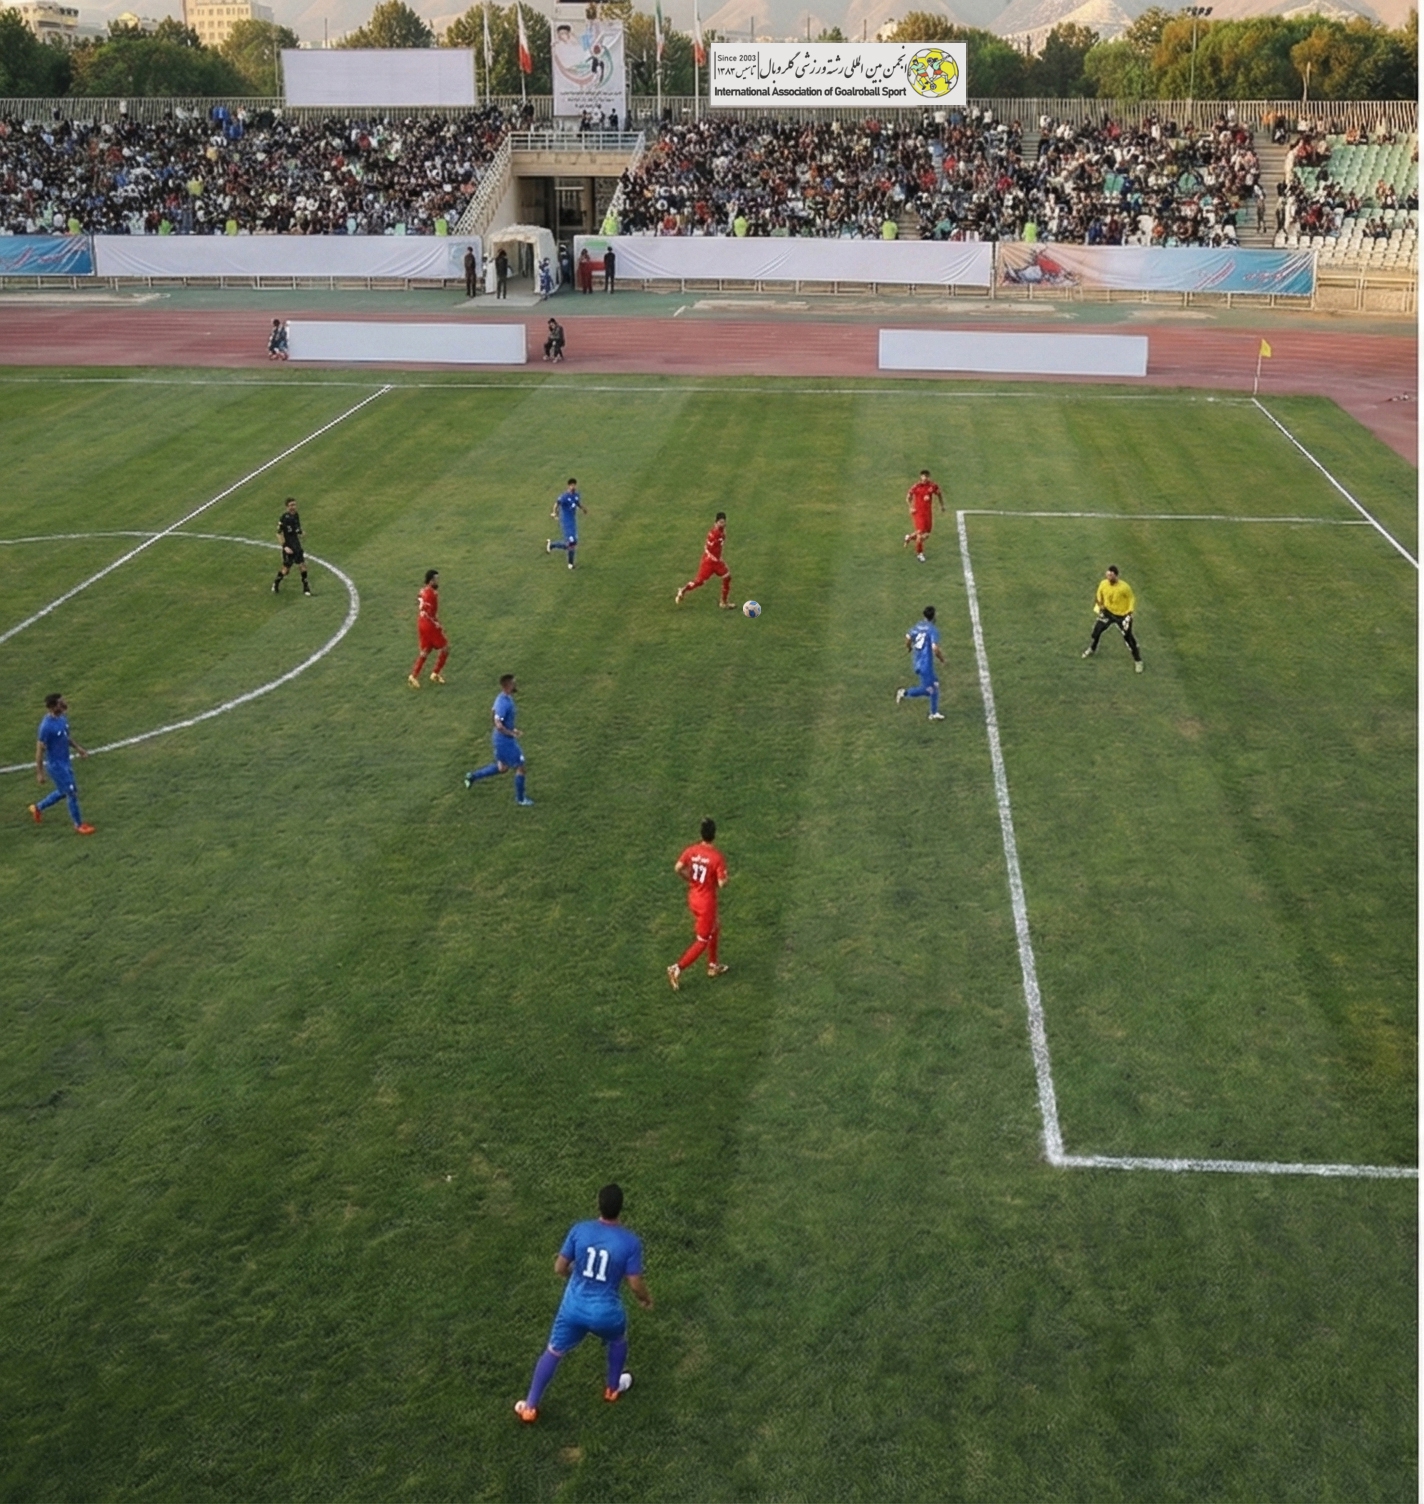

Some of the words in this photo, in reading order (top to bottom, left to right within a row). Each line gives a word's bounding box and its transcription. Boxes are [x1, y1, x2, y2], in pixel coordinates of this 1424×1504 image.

[717, 54, 738, 62] Since
[739, 54, 757, 62] 2003
[795, 51, 827, 79] ورزشی
[826, 54, 844, 75] رشته
[843, 54, 864, 79] المللی
[882, 45, 908, 80] انجمن
[865, 63, 883, 84] بین
[714, 86, 770, 97] International
[771, 86, 823, 97] Association
[824, 86, 834, 97] of
[834, 86, 881, 97] Goalroball
[881, 86, 907, 99] Sport
[582, 1246, 609, 1282] 11
